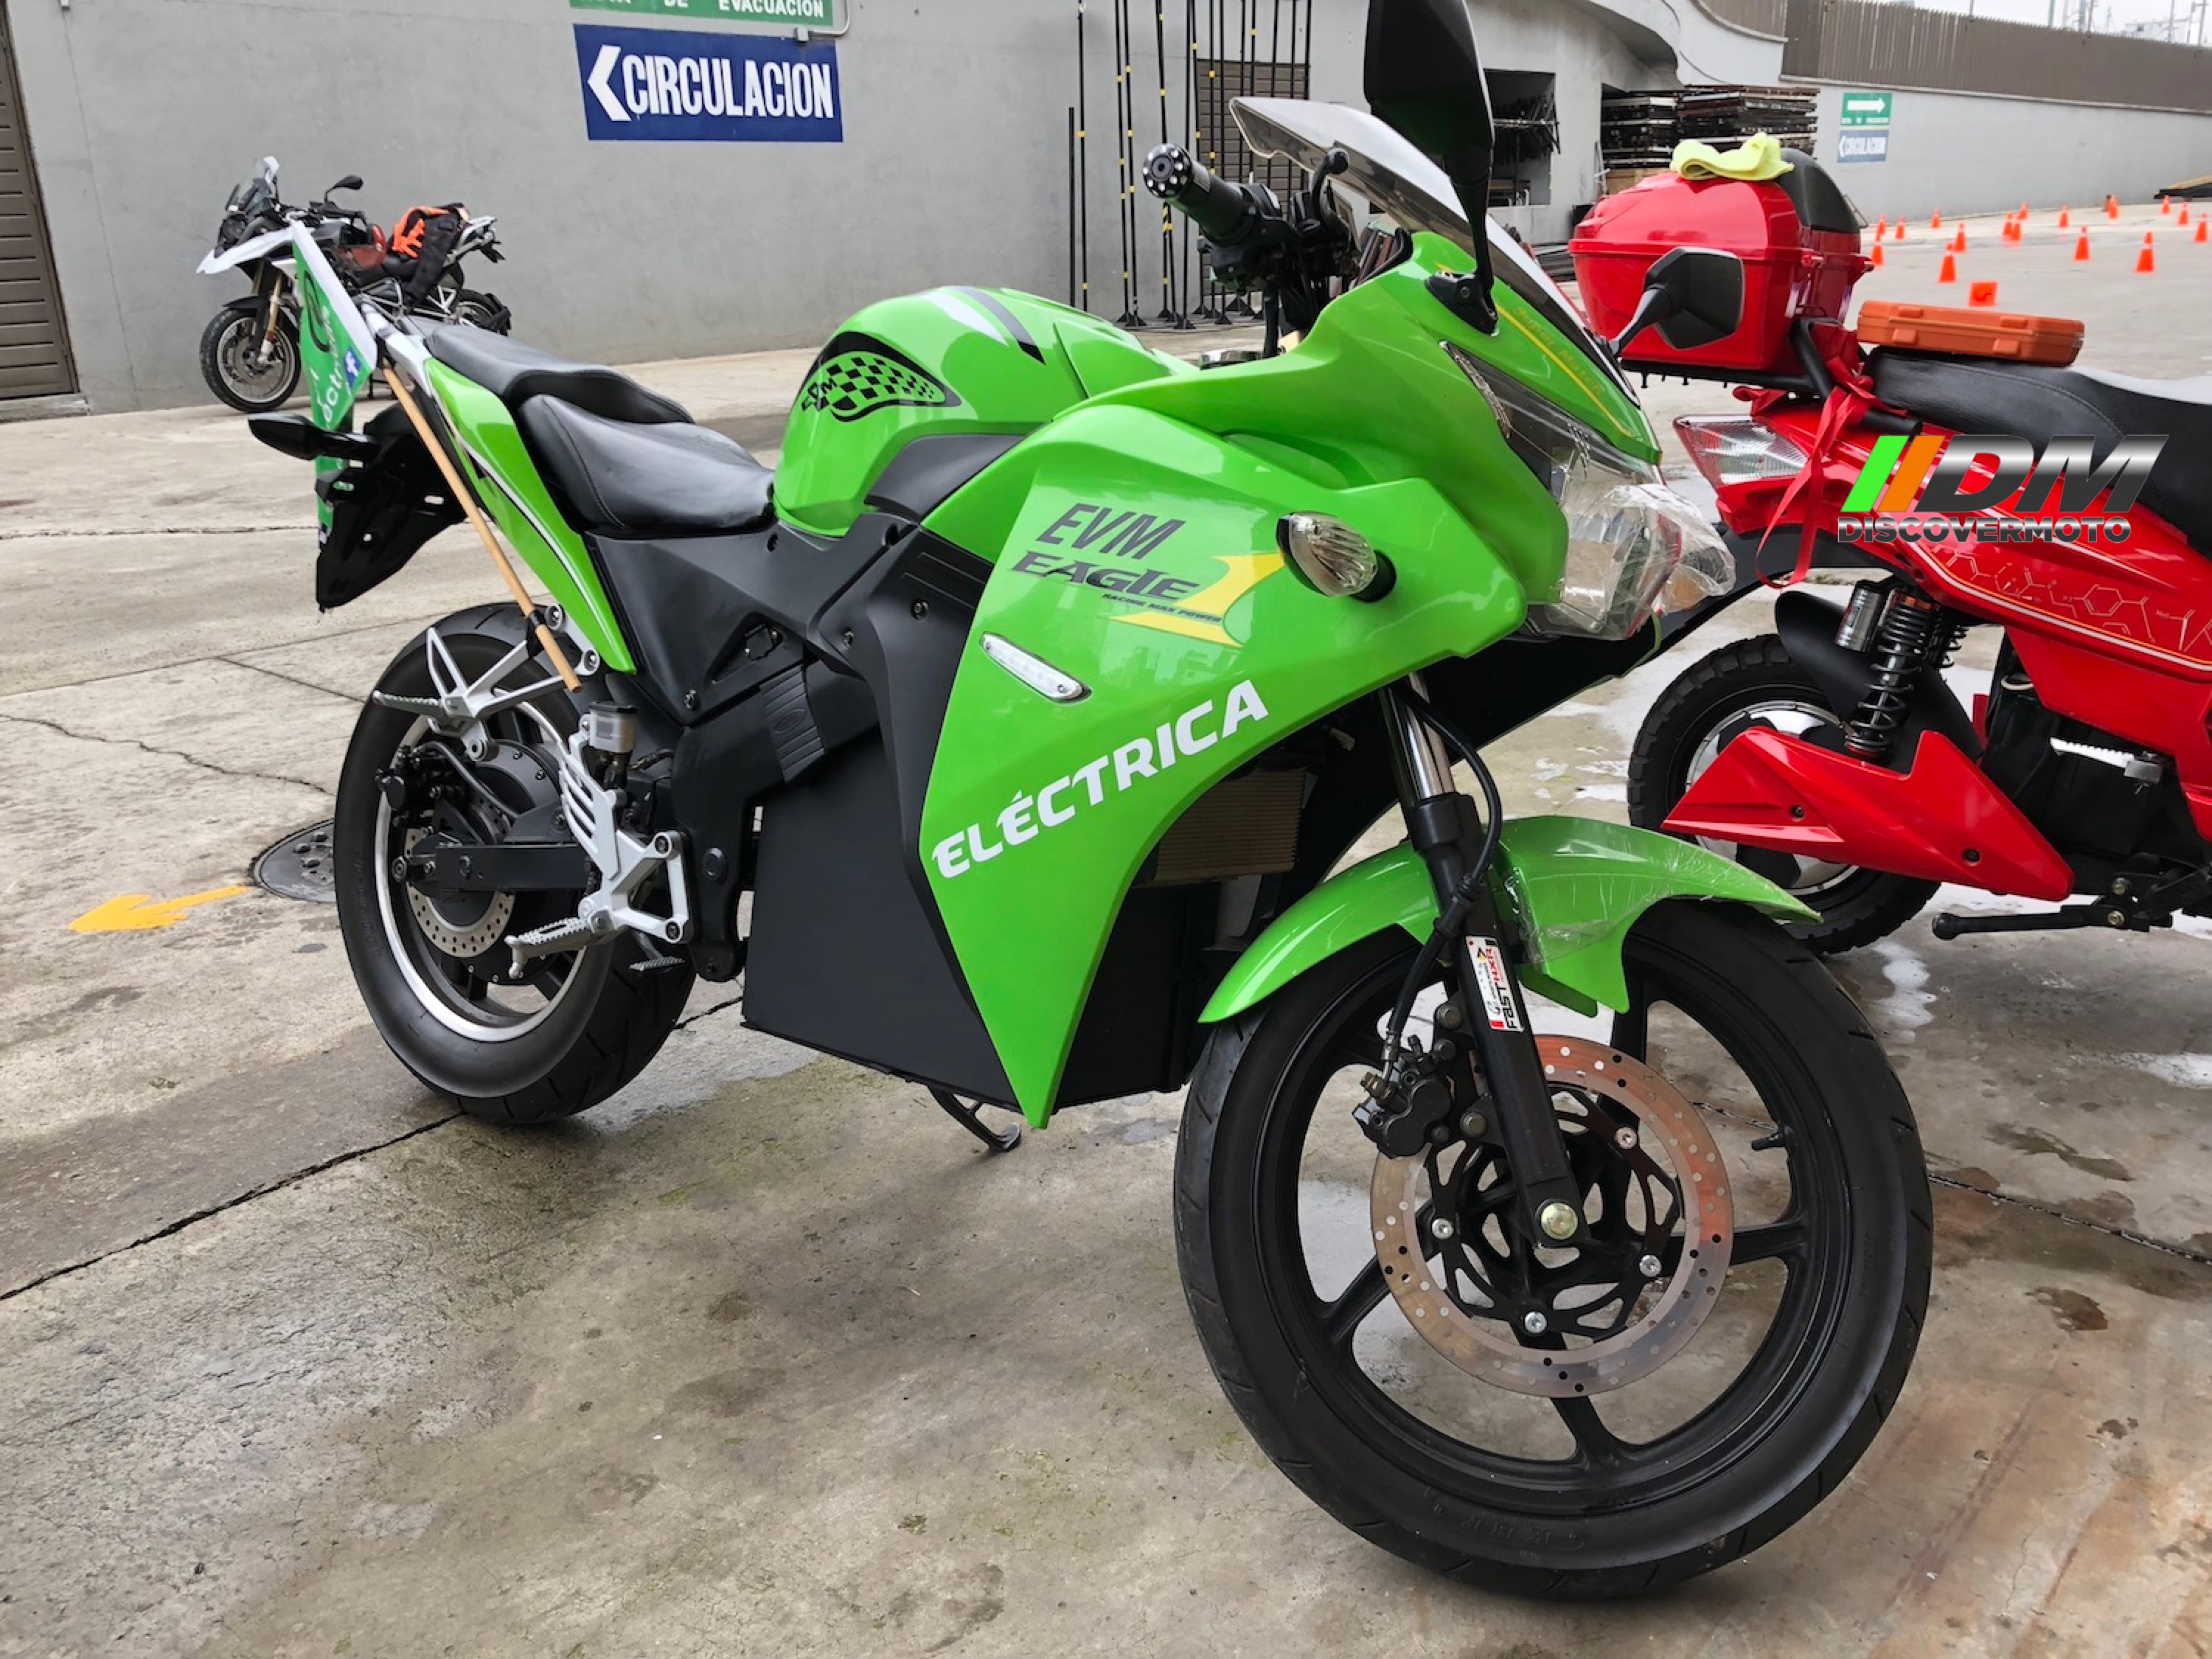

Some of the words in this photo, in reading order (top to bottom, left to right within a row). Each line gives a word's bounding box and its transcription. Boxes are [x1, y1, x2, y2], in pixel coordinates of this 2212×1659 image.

[622, 55, 834, 119] CIRCULACION
[1035, 503, 1186, 560] EVM
[1012, 550, 1200, 601] EAGLE
[931, 679, 1269, 879] ELÉCTRICA
